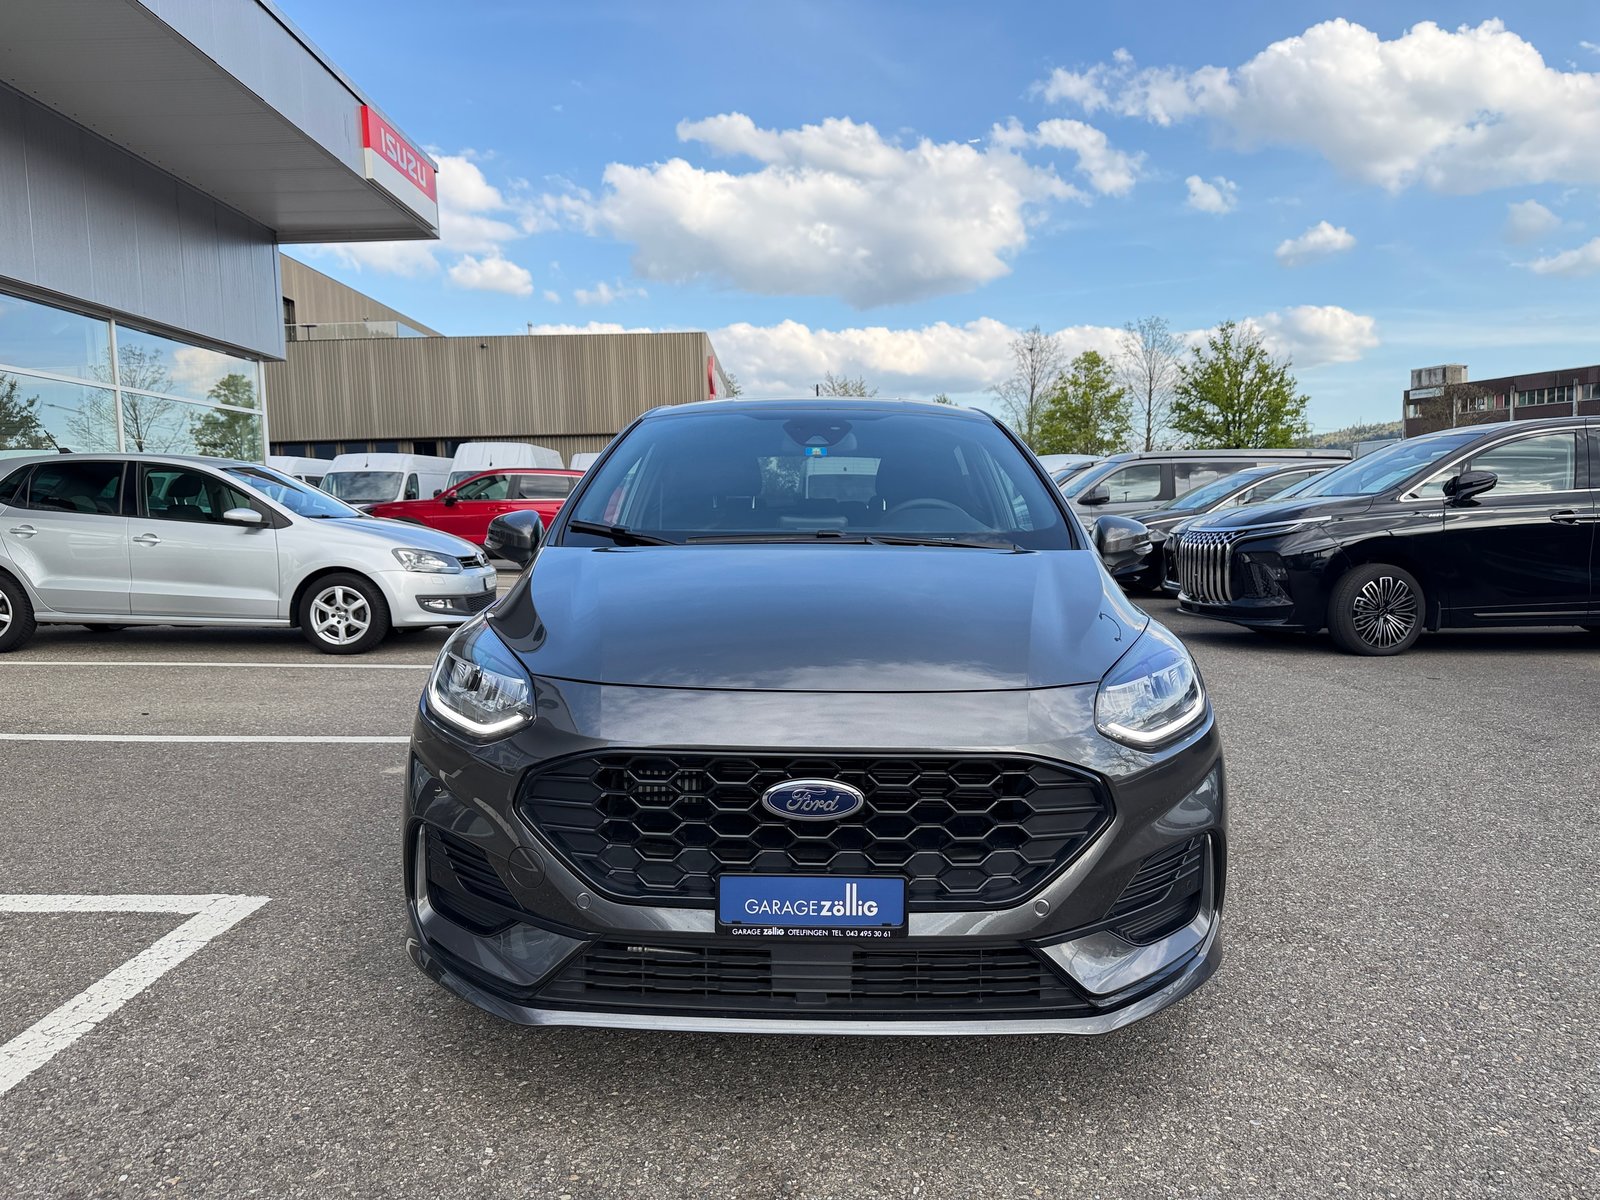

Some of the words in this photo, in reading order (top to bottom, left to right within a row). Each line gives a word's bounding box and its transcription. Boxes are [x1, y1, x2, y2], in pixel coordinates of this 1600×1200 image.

[380, 127, 427, 188] ISUZU
[786, 788, 840, 812] Ford
[744, 898, 818, 916] GARAGE
[732, 928, 761, 936] GARAGE
[787, 929, 829, 937] OTELFINGEN
[860, 930, 872, 938] 495
